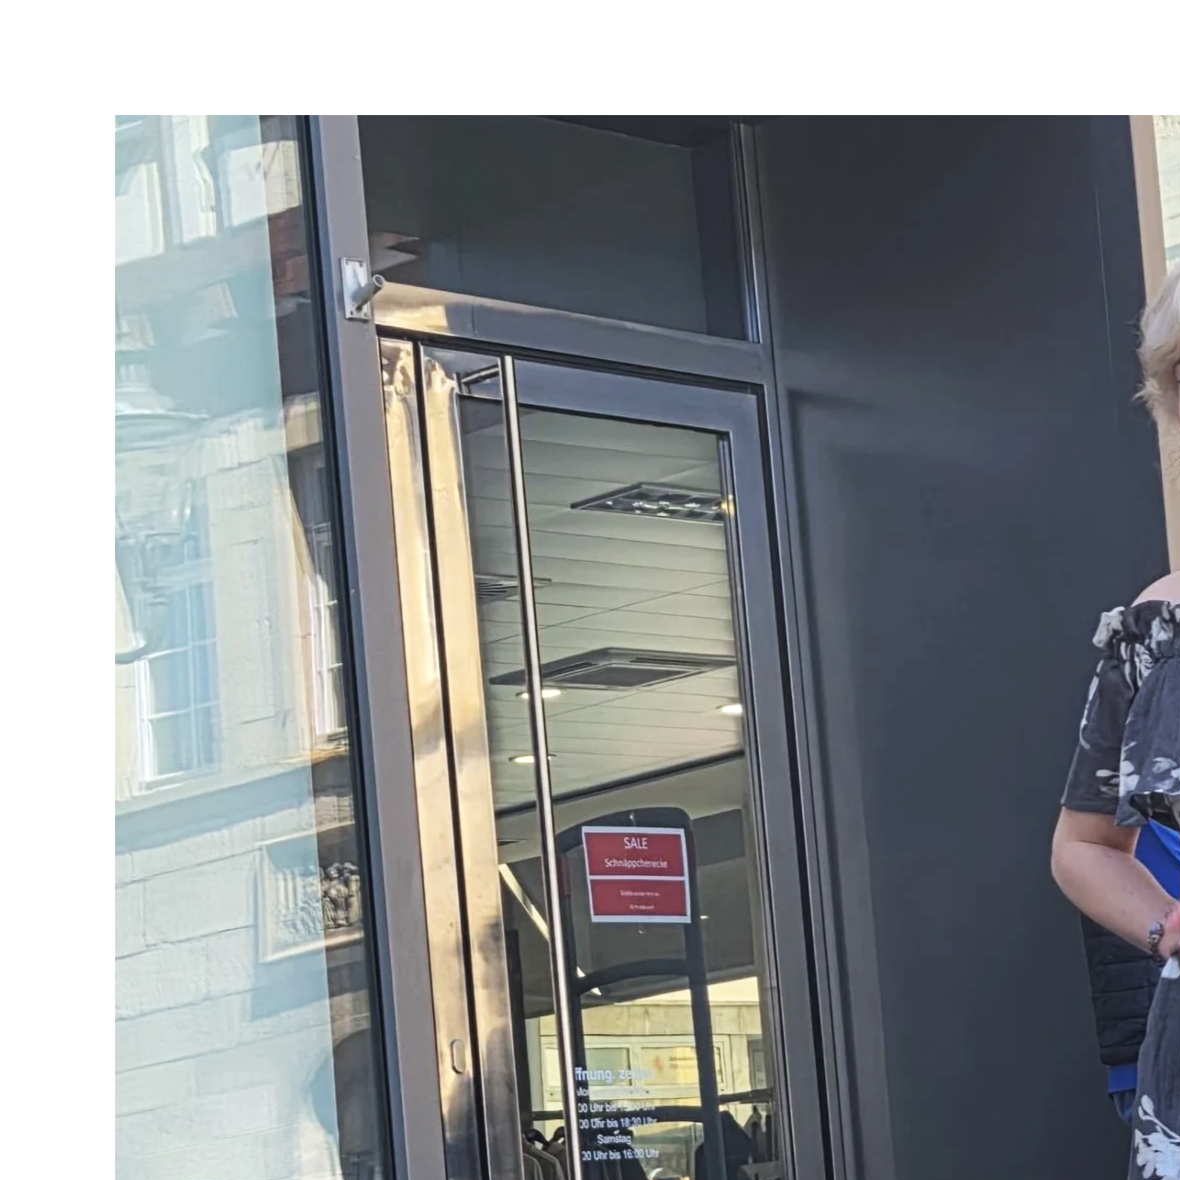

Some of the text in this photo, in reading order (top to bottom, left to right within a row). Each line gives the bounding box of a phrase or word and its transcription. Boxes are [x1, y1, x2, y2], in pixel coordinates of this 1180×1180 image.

[624, 837, 648, 849] SALE
[590, 1103, 604, 1112] Uhr
[591, 1119, 605, 1129] Uhr
[607, 1118, 619, 1128] bis
[597, 1134, 632, 1145] Samstag
[593, 1150, 608, 1160] Uhr
[609, 1149, 621, 1159] bis
[645, 1148, 660, 1158] Uhr
